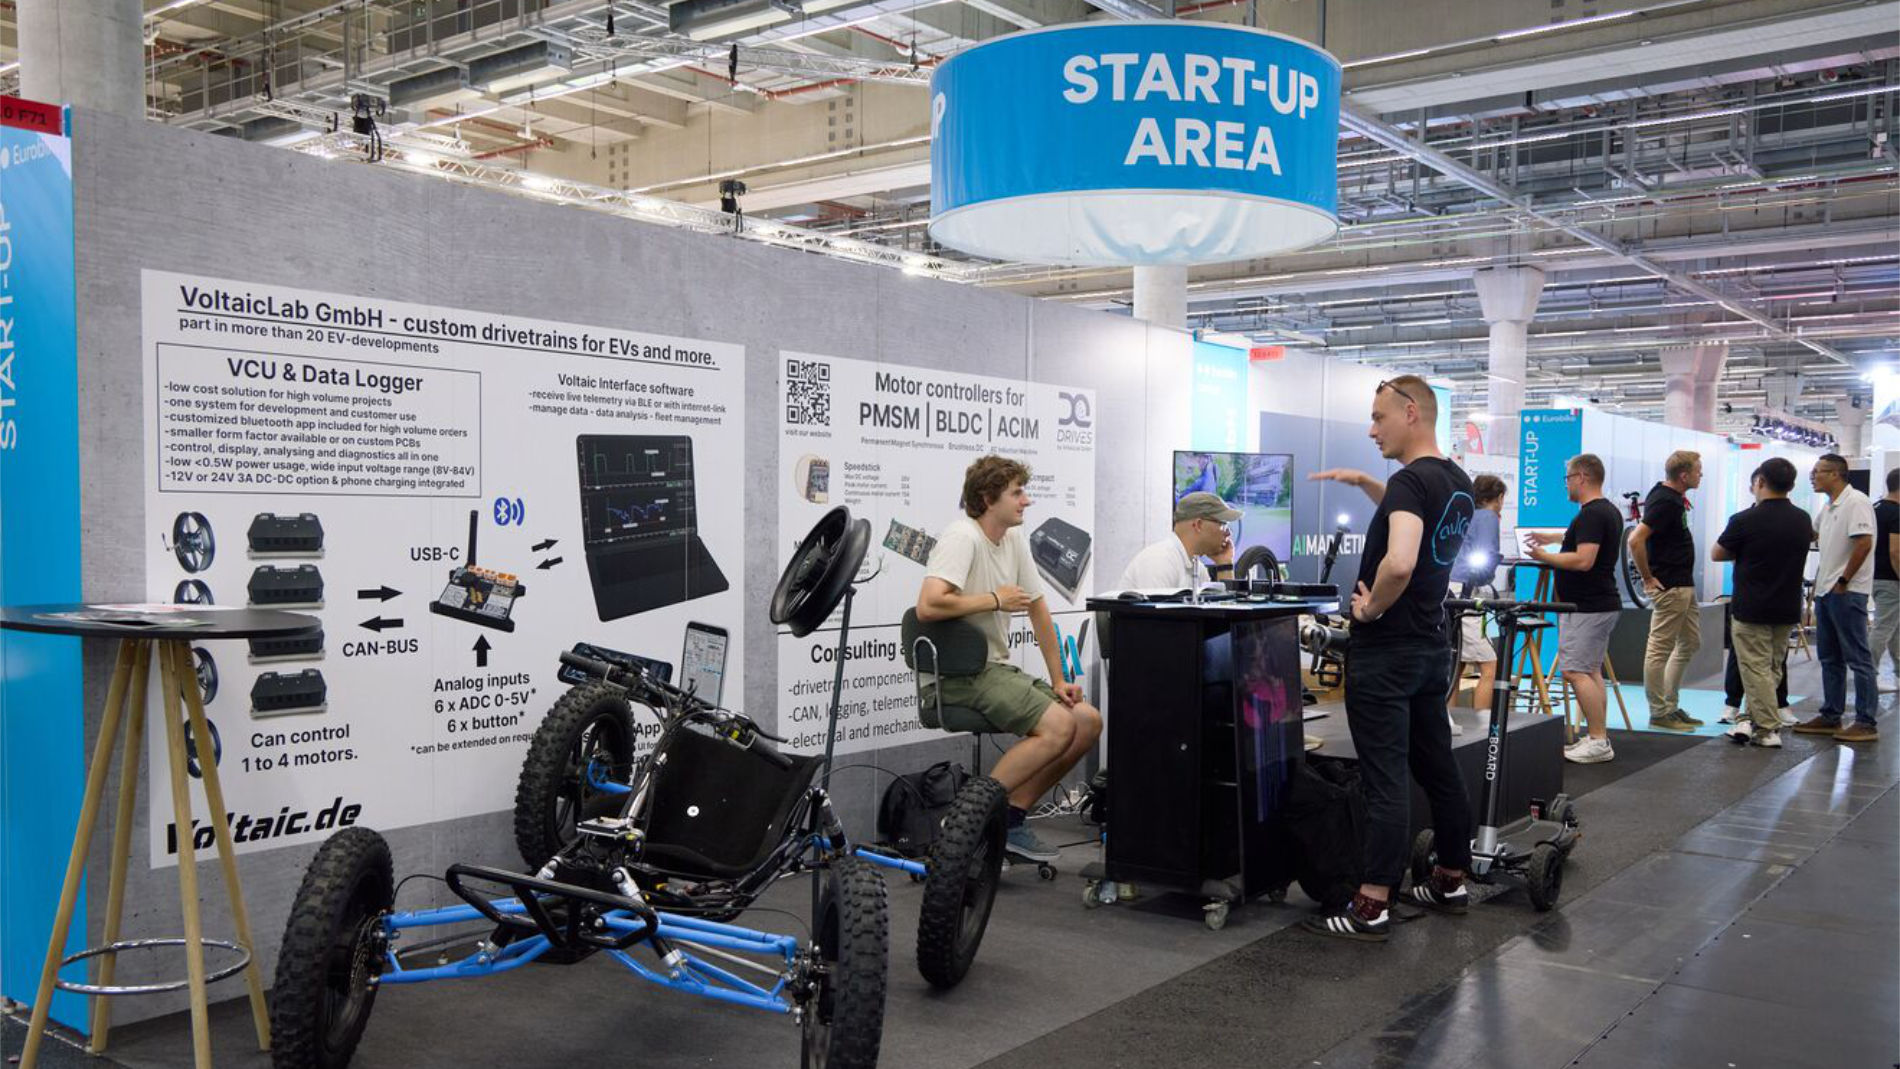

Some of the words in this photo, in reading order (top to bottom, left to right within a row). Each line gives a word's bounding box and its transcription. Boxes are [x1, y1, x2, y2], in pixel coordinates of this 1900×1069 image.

[1063, 53, 1319, 119] START-UP
[1124, 118, 1282, 175] AREA
[180, 285, 309, 320] VoltaicLab
[316, 302, 382, 328] GmbH
[403, 317, 477, 339] custom
[482, 323, 578, 350] drivetrains
[582, 334, 606, 353] for
[609, 338, 639, 357] EVs
[643, 345, 671, 360] and
[675, 350, 716, 365] more.
[180, 318, 211, 331] part
[215, 318, 228, 332] in
[232, 324, 268, 337] more
[272, 326, 303, 340] than
[306, 329, 324, 342] 20
[328, 331, 439, 354] EV-developments
[227, 358, 276, 380] VCU
[283, 363, 296, 382] &
[303, 364, 350, 386] Data
[356, 369, 423, 394] Logger
[558, 373, 597, 388] Voltaic
[599, 377, 647, 393] Interface
[649, 383, 694, 397] software
[164, 381, 191, 392] -low
[193, 385, 218, 395] cost
[221, 386, 267, 398] solution
[269, 388, 284, 399] for
[286, 390, 310, 403] high
[312, 393, 350, 404] volume
[352, 396, 392, 407] projects
[875, 372, 922, 395] Motor
[926, 383, 1003, 404] controllers
[1006, 387, 1025, 407] for
[164, 398, 192, 408] -one
[195, 400, 237, 411] system
[239, 401, 256, 411] for
[257, 403, 328, 417] development
[329, 408, 349, 417] and
[351, 410, 398, 420] customer
[399, 413, 417, 422] use
[529, 391, 565, 401] -receive
[566, 392, 582, 402] live
[583, 394, 623, 407] telemetry
[625, 398, 637, 407] via
[638, 398, 652, 408] BLE
[664, 401, 680, 410] with
[681, 403, 726, 413] internet-link
[164, 413, 238, 425] -customized
[240, 416, 294, 428] bluetooth
[296, 420, 316, 431] app
[318, 420, 362, 432] included
[364, 423, 378, 433] for
[380, 424, 401, 436] high
[403, 426, 438, 436] volume
[529, 405, 568, 416] -manage
[569, 406, 588, 416] data
[596, 408, 614, 418] data
[615, 410, 648, 421] analysis
[655, 412, 673, 422] fleet
[674, 415, 721, 425] management
[860, 402, 919, 430] PMSM
[936, 410, 982, 435] BLDC
[997, 415, 1039, 440] ACIM
[165, 428, 214, 438] -smaller
[216, 429, 243, 440] form
[245, 431, 278, 441] factor
[280, 434, 327, 444] available
[329, 436, 340, 444] or
[342, 437, 355, 445] on
[357, 437, 394, 447] custom
[395, 438, 421, 448] PCBs
[1057, 429, 1092, 445] DRIVES
[165, 443, 215, 454] -control,
[217, 444, 261, 457] display,
[263, 447, 315, 459] analysing
[316, 448, 336, 458] and
[338, 449, 396, 461] diagnostics
[397, 452, 409, 460] all
[410, 452, 420, 461] in
[421, 454, 439, 462] one
[165, 457, 192, 466] -low
[195, 458, 233, 468] <0.5W
[236, 461, 270, 471] power
[273, 462, 308, 472] usage,
[310, 461, 336, 472] wide
[337, 462, 364, 474] input
[365, 464, 402, 476] voltage
[403, 466, 430, 476] range
[844, 461, 881, 473] Speedstick
[1523, 430, 1540, 506] START-UP
[165, 472, 194, 482] -12V
[196, 474, 208, 482] or
[211, 473, 235, 483] 24V
[238, 474, 253, 483] 3A
[256, 474, 294, 484] DC-DC
[296, 475, 330, 486] option
[341, 476, 372, 487] phone
[374, 477, 416, 489] charging
[418, 478, 465, 489] integrated
[411, 547, 459, 561] USB-C
[342, 638, 418, 657] CAN-BUS
[434, 676, 484, 692] Analog
[488, 673, 530, 690] inputs
[788, 679, 849, 696] -drivetrn
[435, 699, 444, 714] 6
[448, 701, 456, 712] x
[459, 695, 491, 711] ADC
[788, 705, 822, 722] -CAN,
[826, 700, 870, 720] lgging,
[873, 695, 918, 711] telemetr
[251, 733, 286, 748] Can
[290, 724, 350, 744] control
[448, 719, 456, 733] 6
[460, 721, 468, 732] x
[788, 726, 846, 748] -electral
[849, 723, 870, 740] and
[873, 716, 922, 736] mechanic
[437, 742, 450, 752] be
[452, 736, 497, 750] extended
[498, 736, 511, 744] on
[512, 733, 535, 743] requ
[242, 757, 249, 773] 1
[255, 757, 273, 771] to
[278, 753, 289, 768] 4
[294, 749, 358, 766] motors.
